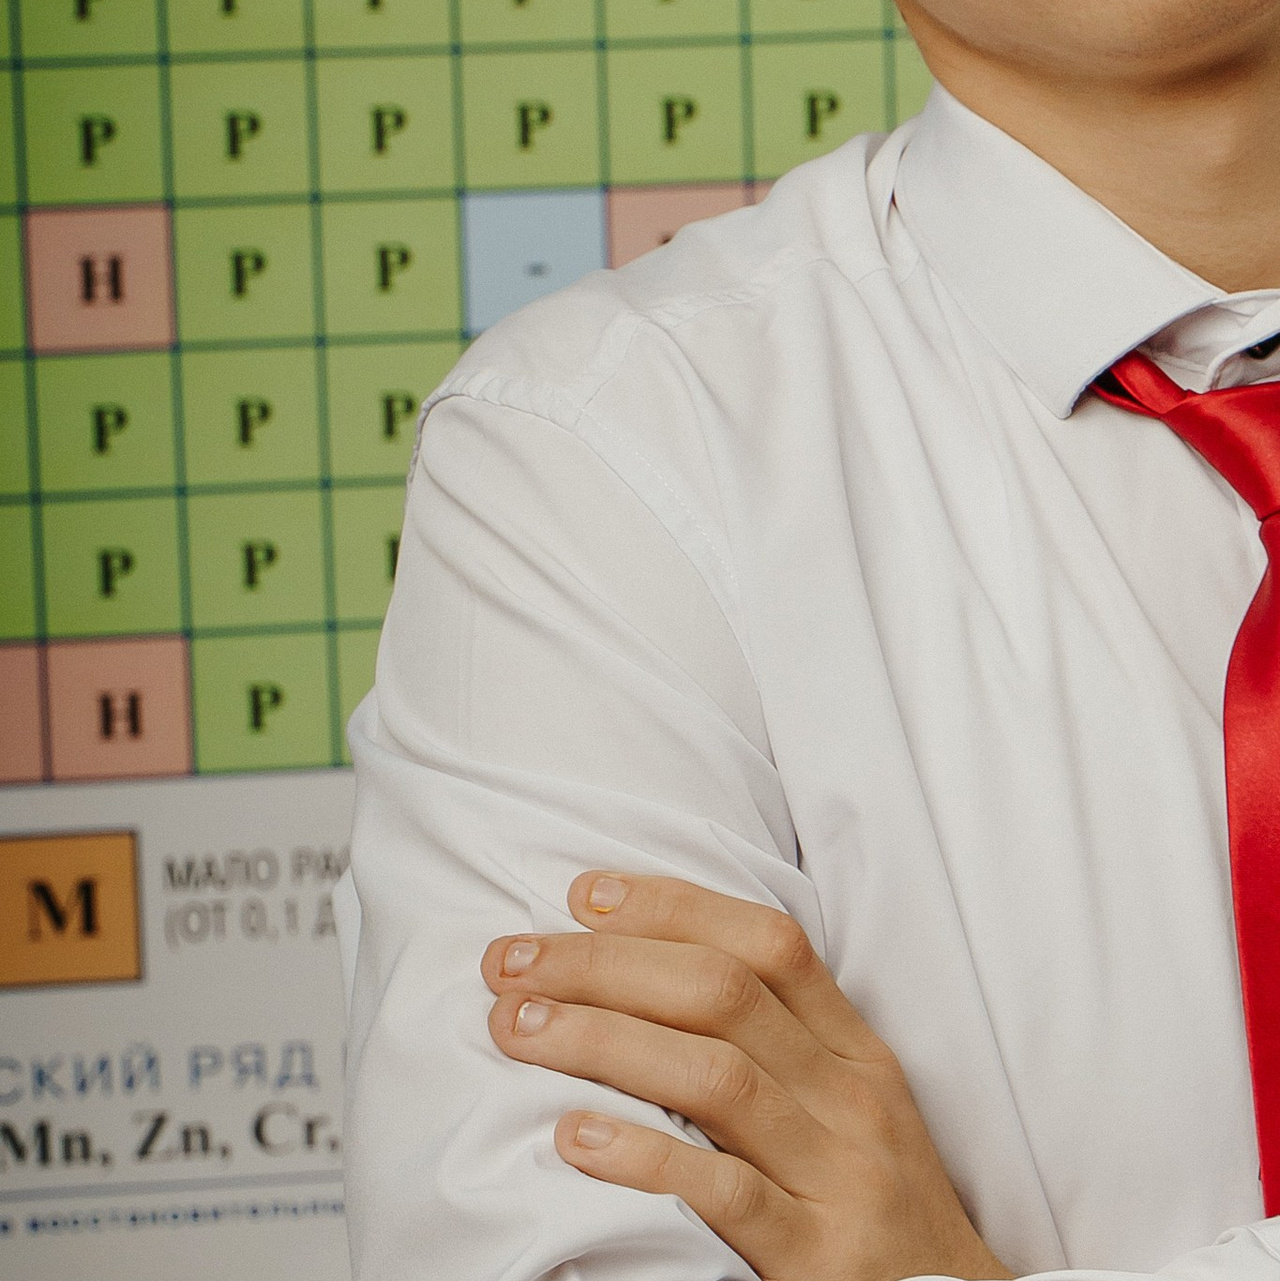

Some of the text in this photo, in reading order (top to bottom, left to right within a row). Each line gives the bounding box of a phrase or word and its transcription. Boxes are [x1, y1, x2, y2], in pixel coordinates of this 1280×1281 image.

[77, 97, 697, 168] Р Р Р Р
[78, 244, 412, 307] Н Р Р
[90, 398, 273, 456] Р Р
[96, 541, 279, 600] Р Р
[96, 683, 285, 743] Н Р
[26, 875, 101, 942] М
[188, 1039, 320, 1090] РЯД
[133, 1109, 232, 1161] Zn,
[252, 1101, 343, 1156] Cr,
